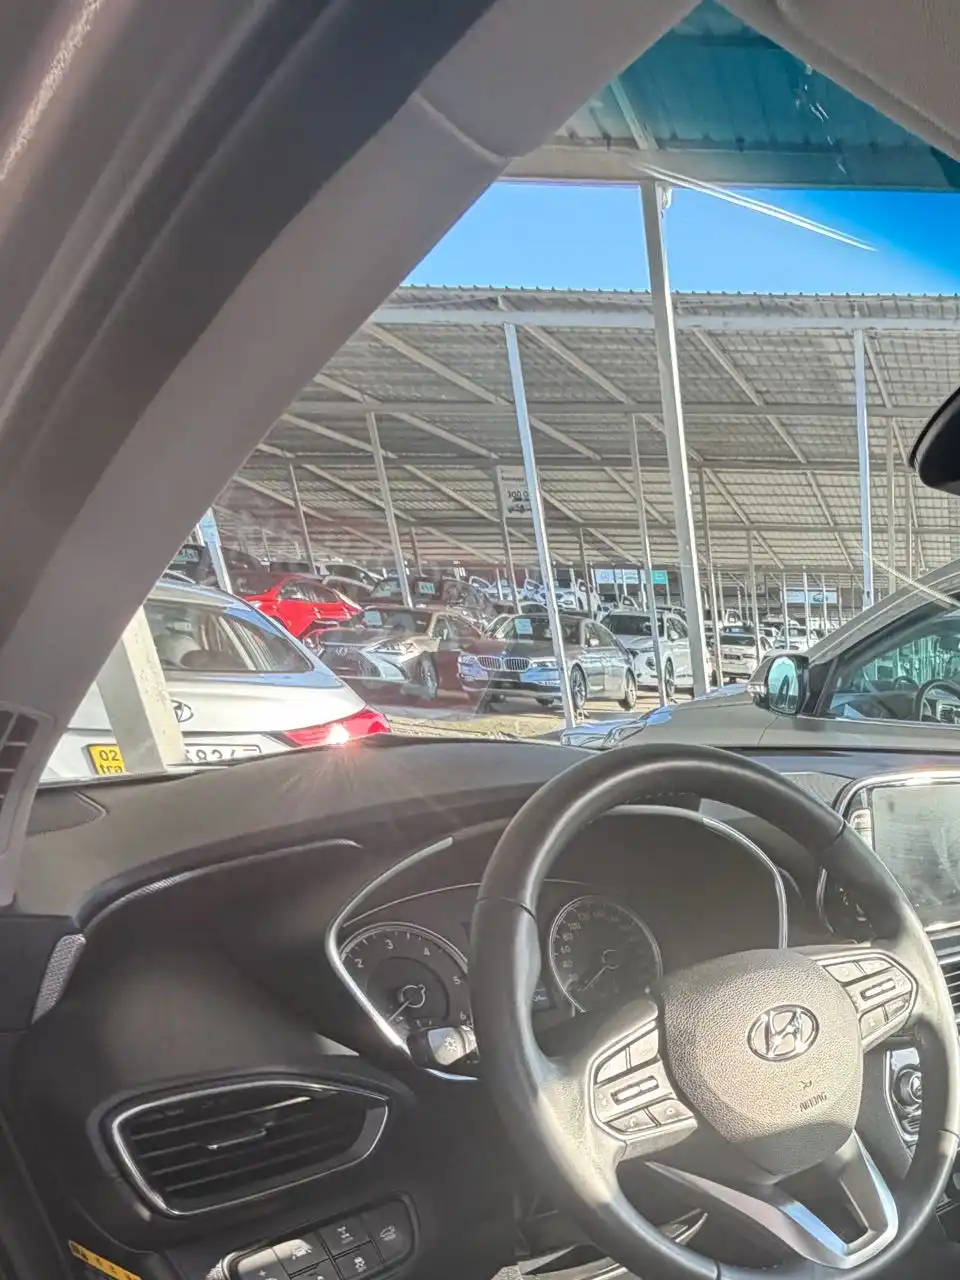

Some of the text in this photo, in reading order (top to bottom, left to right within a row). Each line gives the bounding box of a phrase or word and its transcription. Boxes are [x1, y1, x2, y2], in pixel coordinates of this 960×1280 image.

[99, 749, 118, 762] 02
[384, 939, 394, 950] 3
[354, 958, 364, 968] 2
[452, 976, 461, 985] 5
